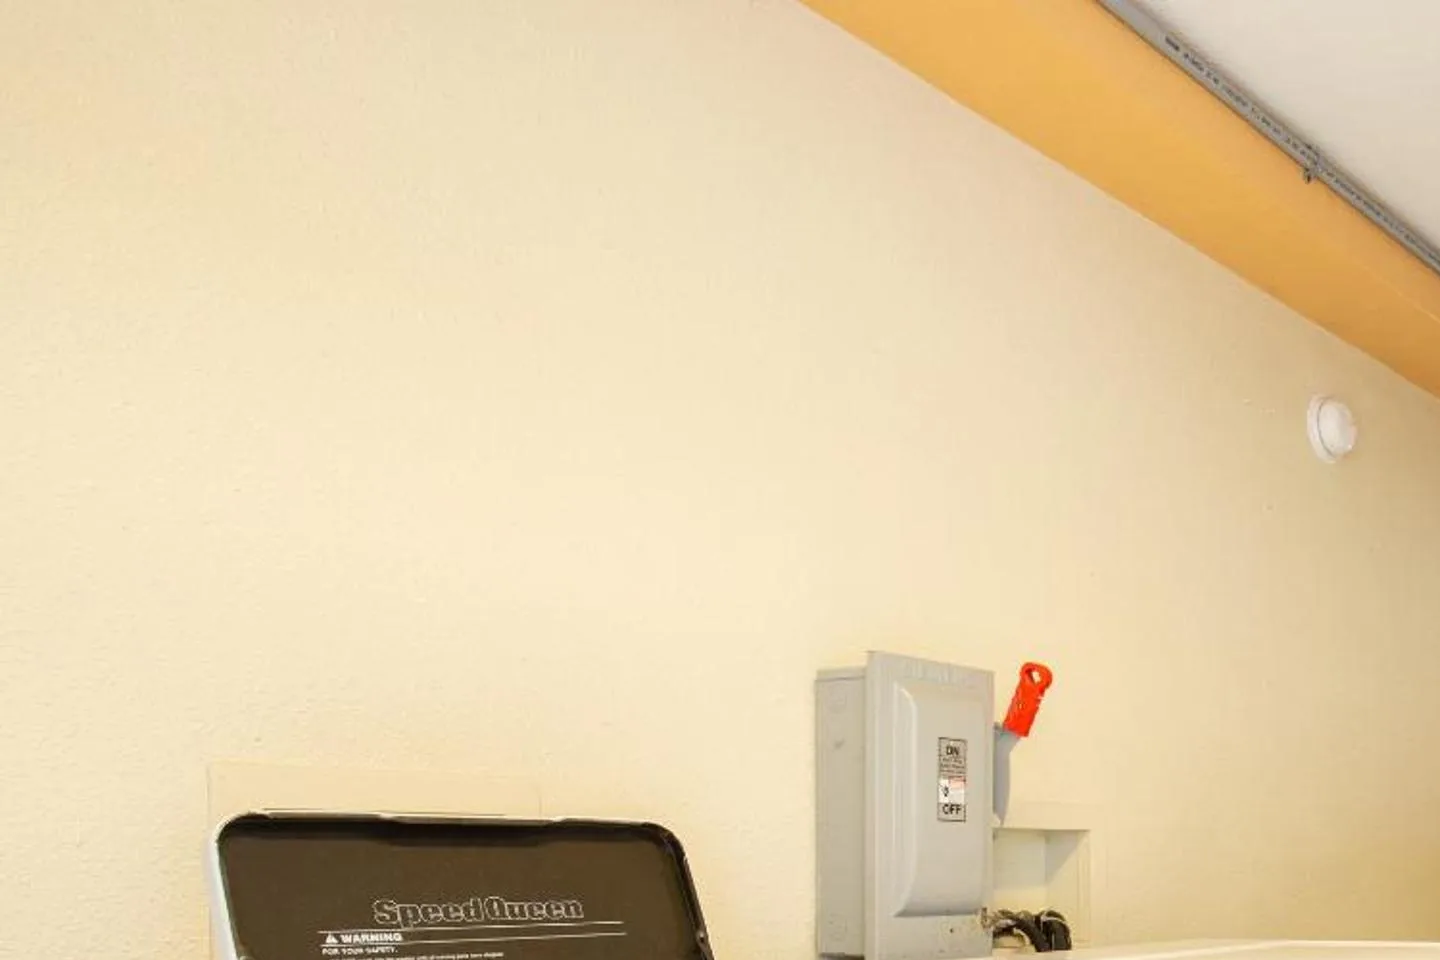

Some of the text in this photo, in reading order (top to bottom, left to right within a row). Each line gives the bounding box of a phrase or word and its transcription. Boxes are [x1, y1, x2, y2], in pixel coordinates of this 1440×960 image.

[372, 896, 584, 930] Speed Queen
[340, 932, 403, 945] WARNING
